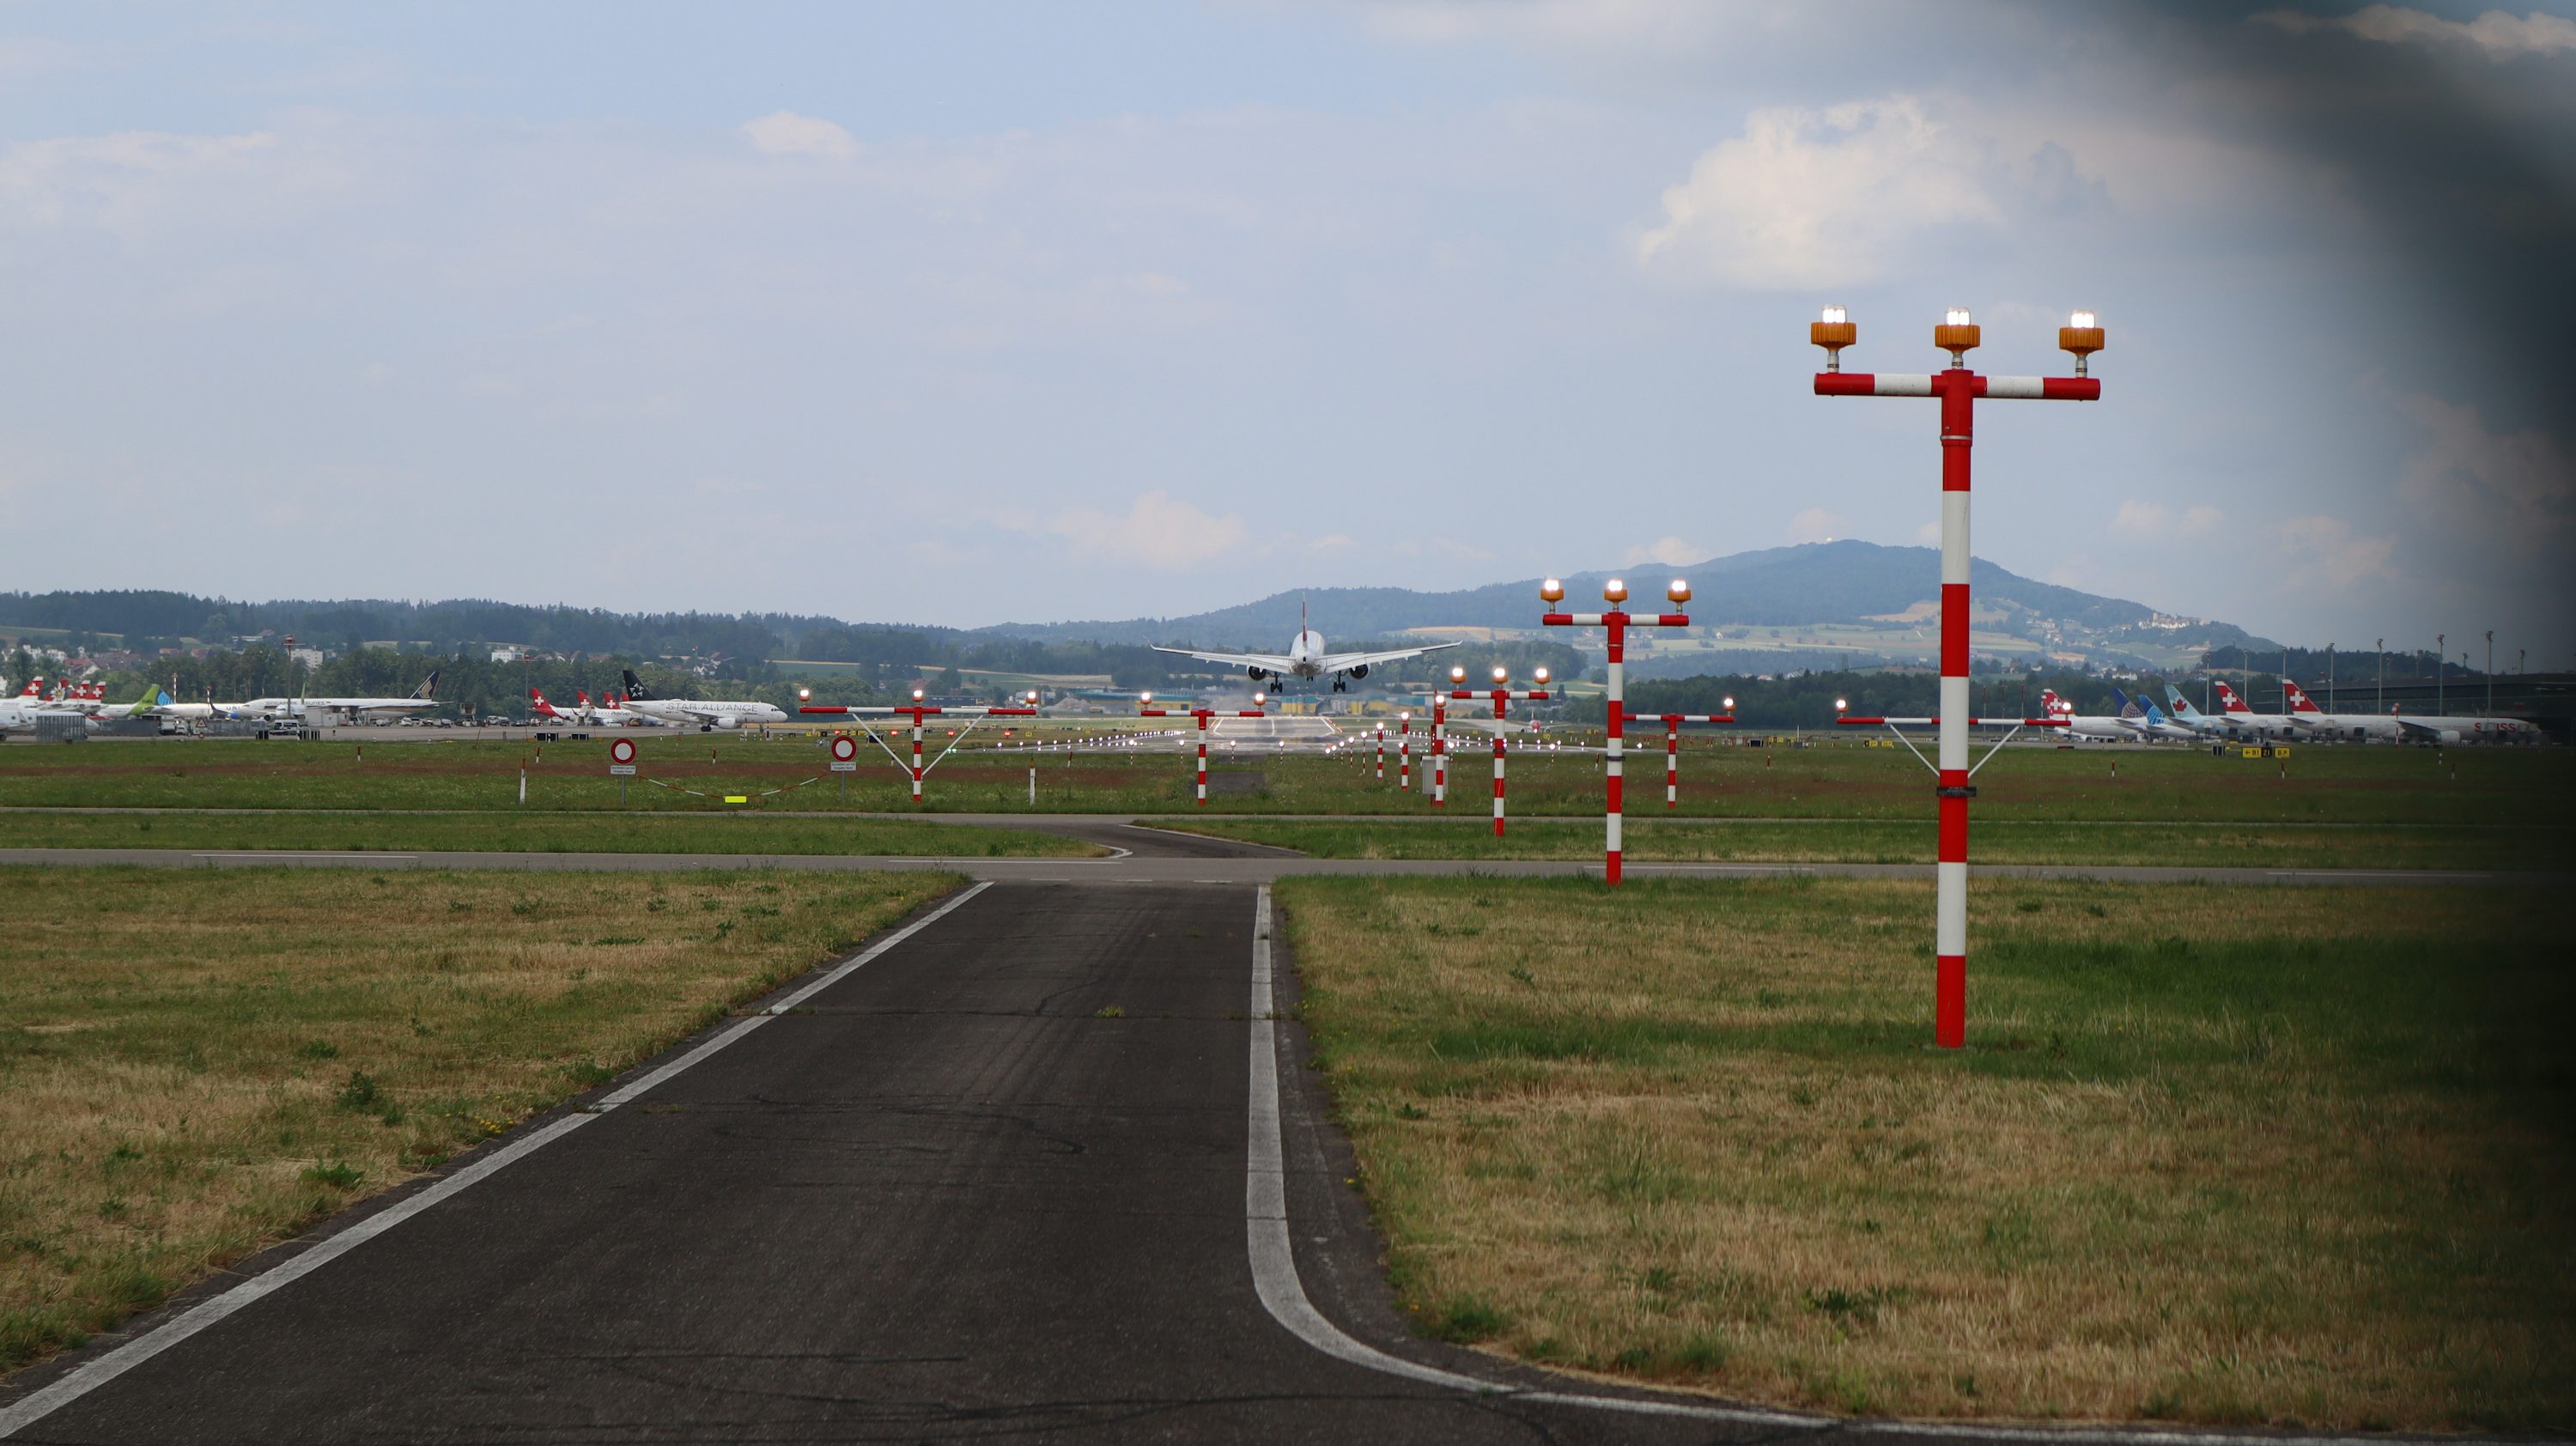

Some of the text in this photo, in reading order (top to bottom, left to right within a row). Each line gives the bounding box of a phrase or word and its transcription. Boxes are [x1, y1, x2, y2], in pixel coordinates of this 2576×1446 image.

[666, 702, 758, 712] STAR ALLIANCE
[2475, 722, 2516, 733] SISS
